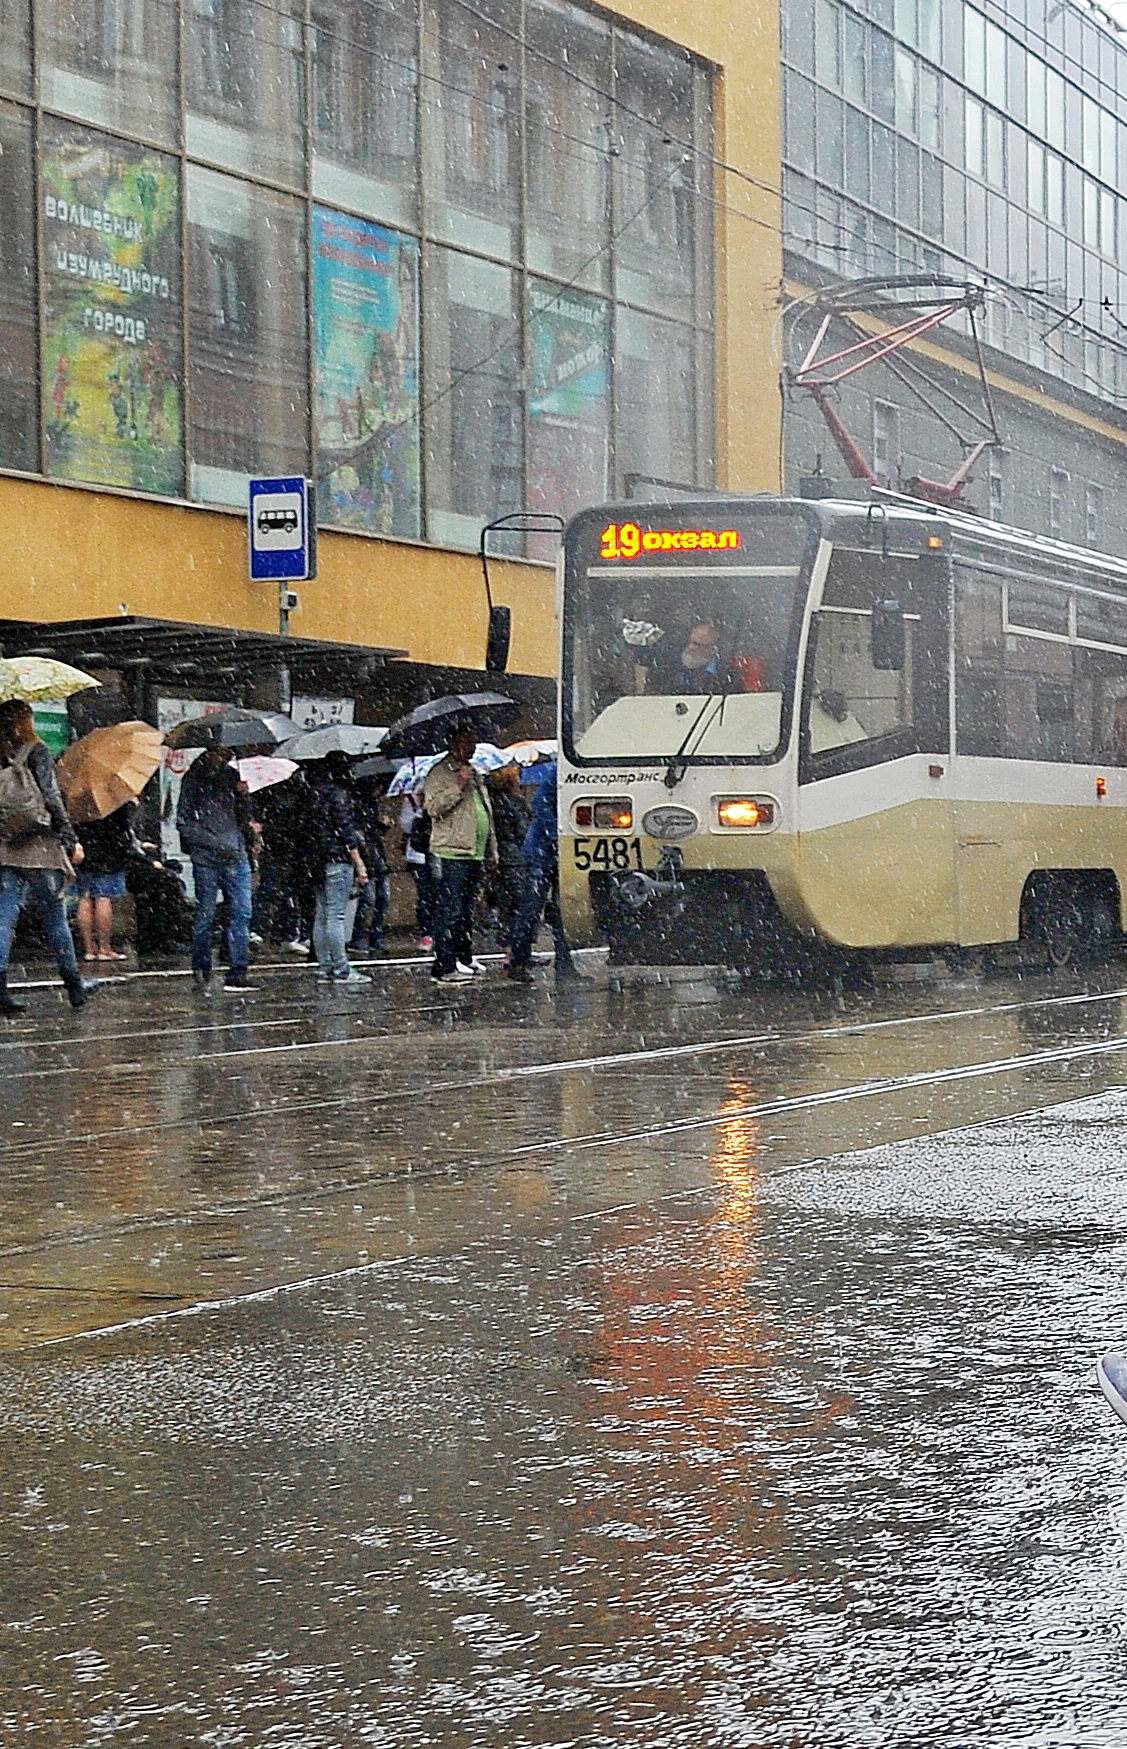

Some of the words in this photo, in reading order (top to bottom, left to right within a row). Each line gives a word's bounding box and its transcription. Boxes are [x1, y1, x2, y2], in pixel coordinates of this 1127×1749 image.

[601, 522, 641, 560] 19
[564, 772, 660, 786] Мосгортранс
[574, 838, 642, 870] 5481
